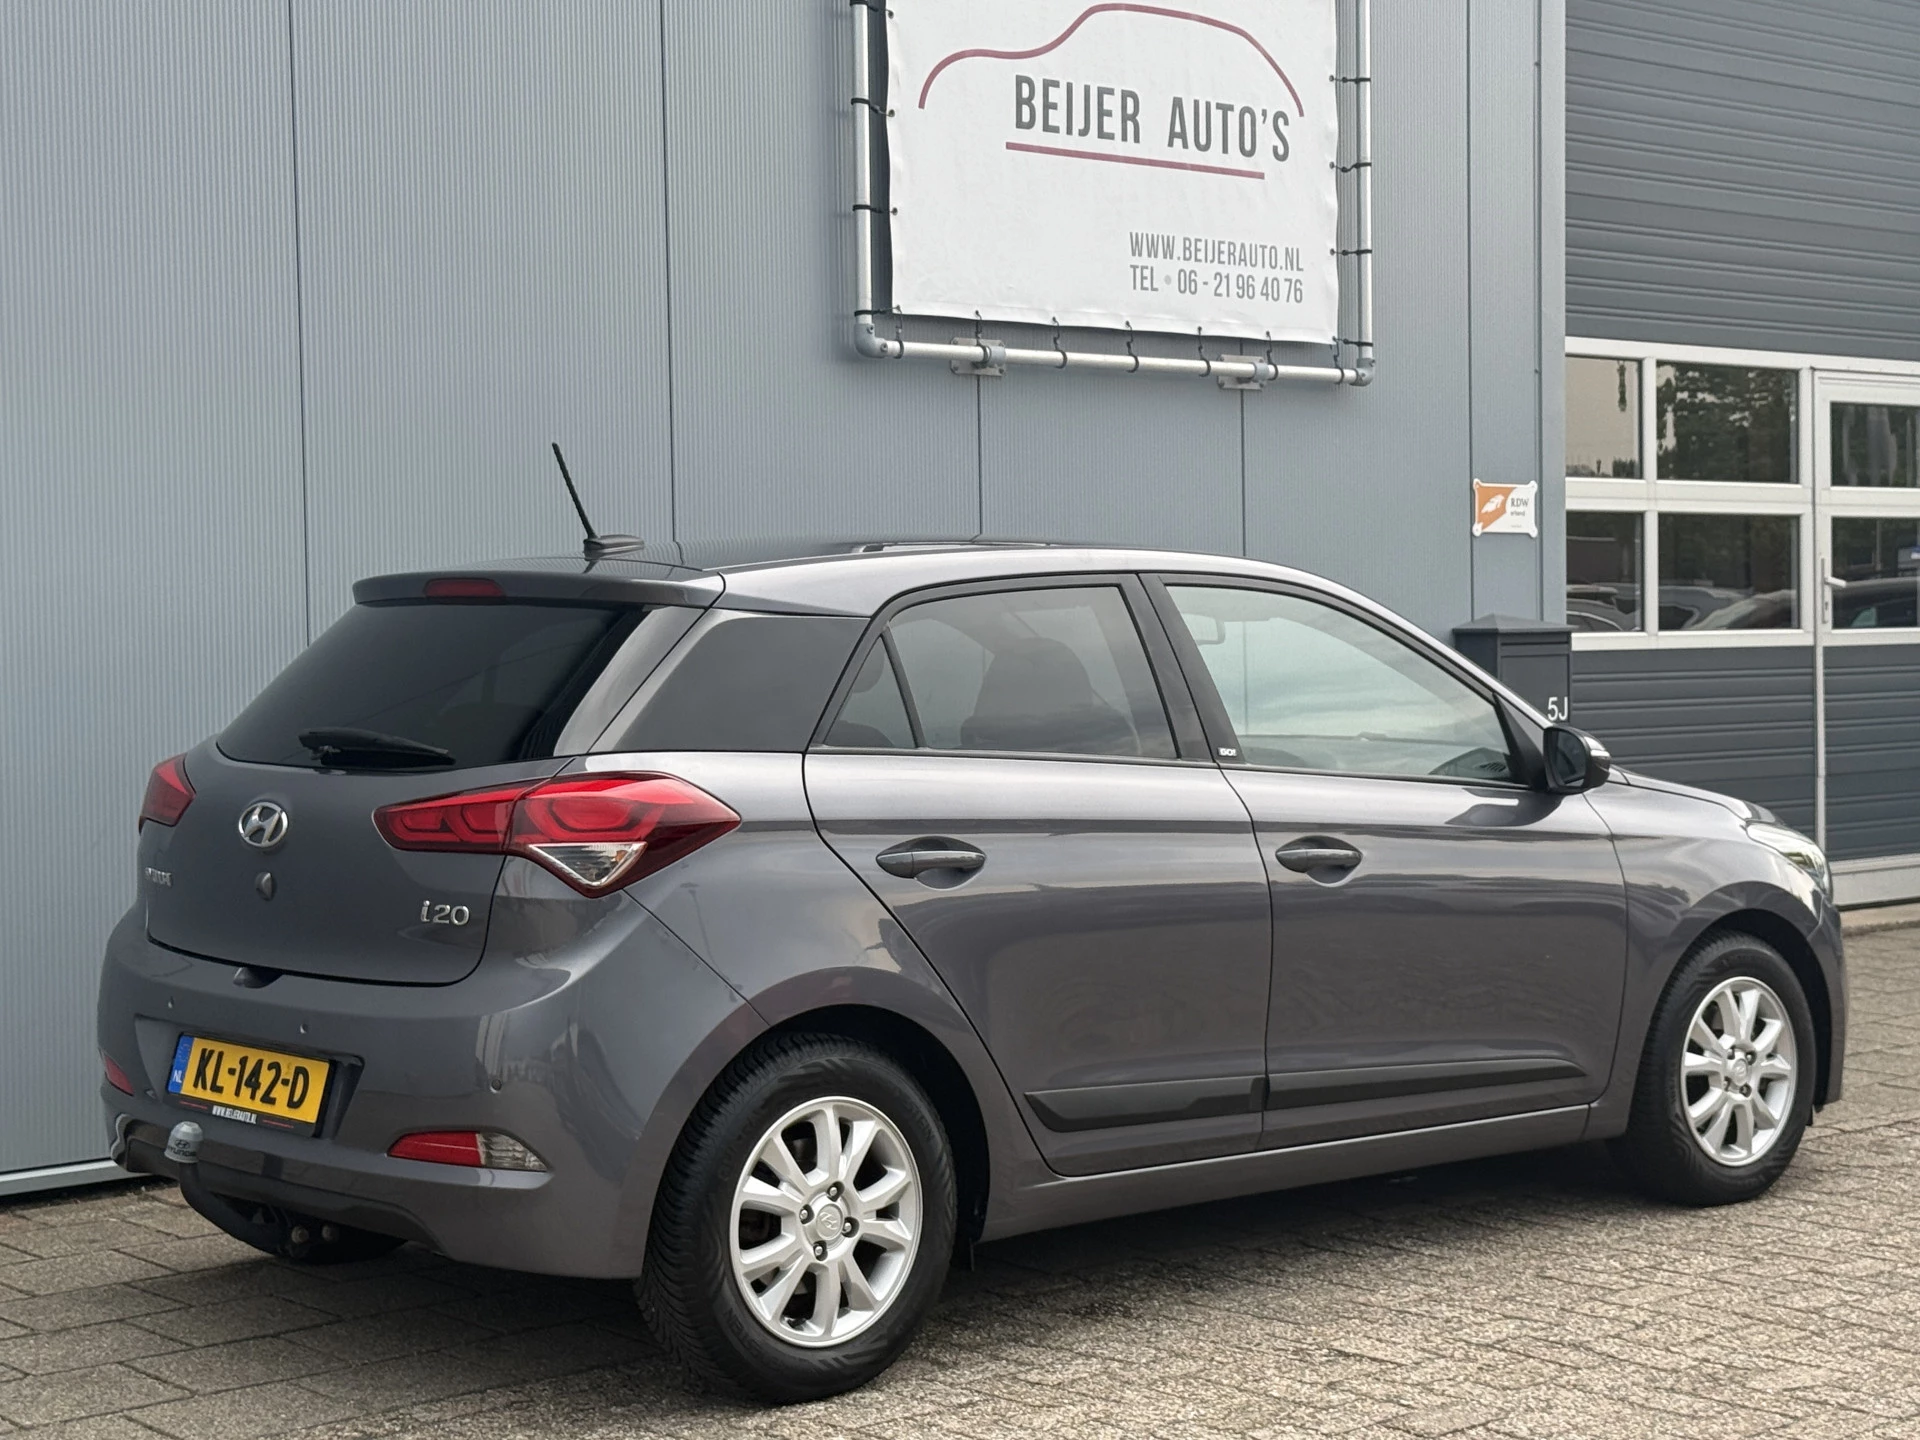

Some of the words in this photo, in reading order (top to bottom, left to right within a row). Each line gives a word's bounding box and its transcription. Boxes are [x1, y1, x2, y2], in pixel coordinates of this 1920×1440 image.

[1015, 74, 1140, 144] BEIJER
[1167, 96, 1290, 162] AUTO'S
[1129, 231, 1304, 272] WWW.BEIJERAUTO.NL
[1130, 264, 1159, 292] TEL
[1177, 268, 1198, 295] 06
[1547, 696, 1569, 721] 5J
[420, 900, 470, 926] i20
[173, 1068, 183, 1084] NL
[192, 1047, 310, 1110] KL-142-D
